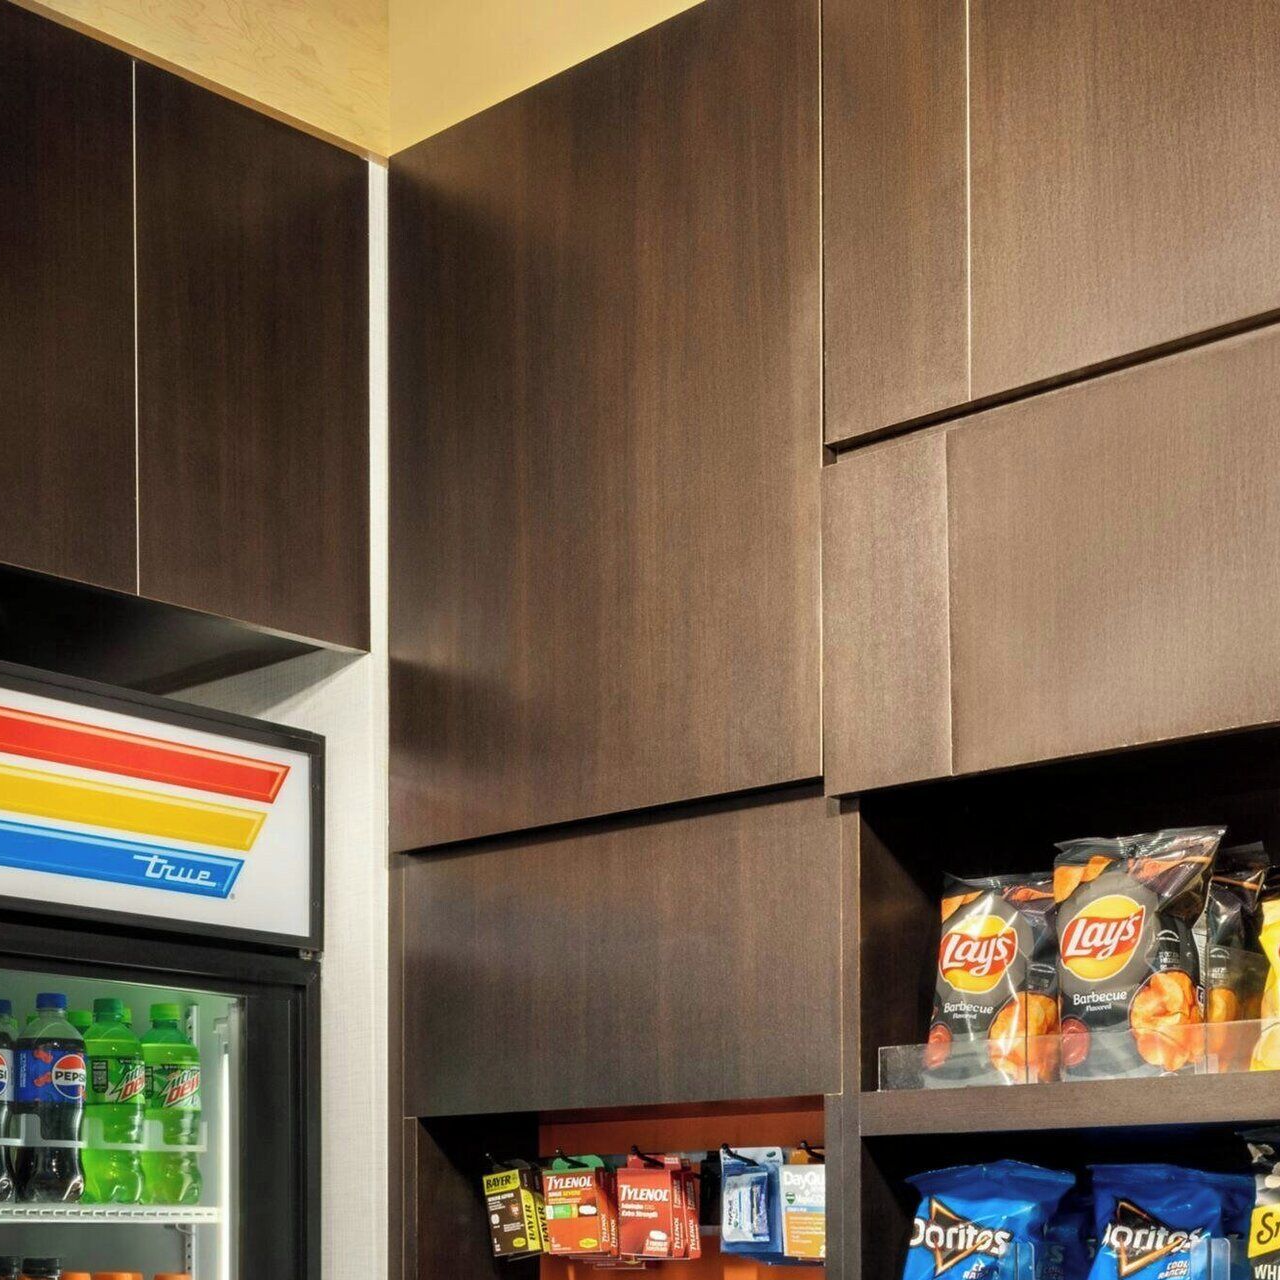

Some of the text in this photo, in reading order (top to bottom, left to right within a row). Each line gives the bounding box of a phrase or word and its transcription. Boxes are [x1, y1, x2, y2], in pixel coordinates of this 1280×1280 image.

[133, 853, 218, 887] true
[1065, 913, 1141, 960] Lay's
[1073, 991, 1127, 1006] Barbecue
[943, 1002, 994, 1015] Barbecue
[1085, 1002, 1113, 1012] Flavored
[546, 1175, 593, 1190] TYLENOL
[620, 1185, 670, 1203] TYLENOL
[909, 1217, 1014, 1255] Doritos
[1167, 1260, 1190, 1269] COOL
[1158, 1268, 1189, 1280] RANCH
